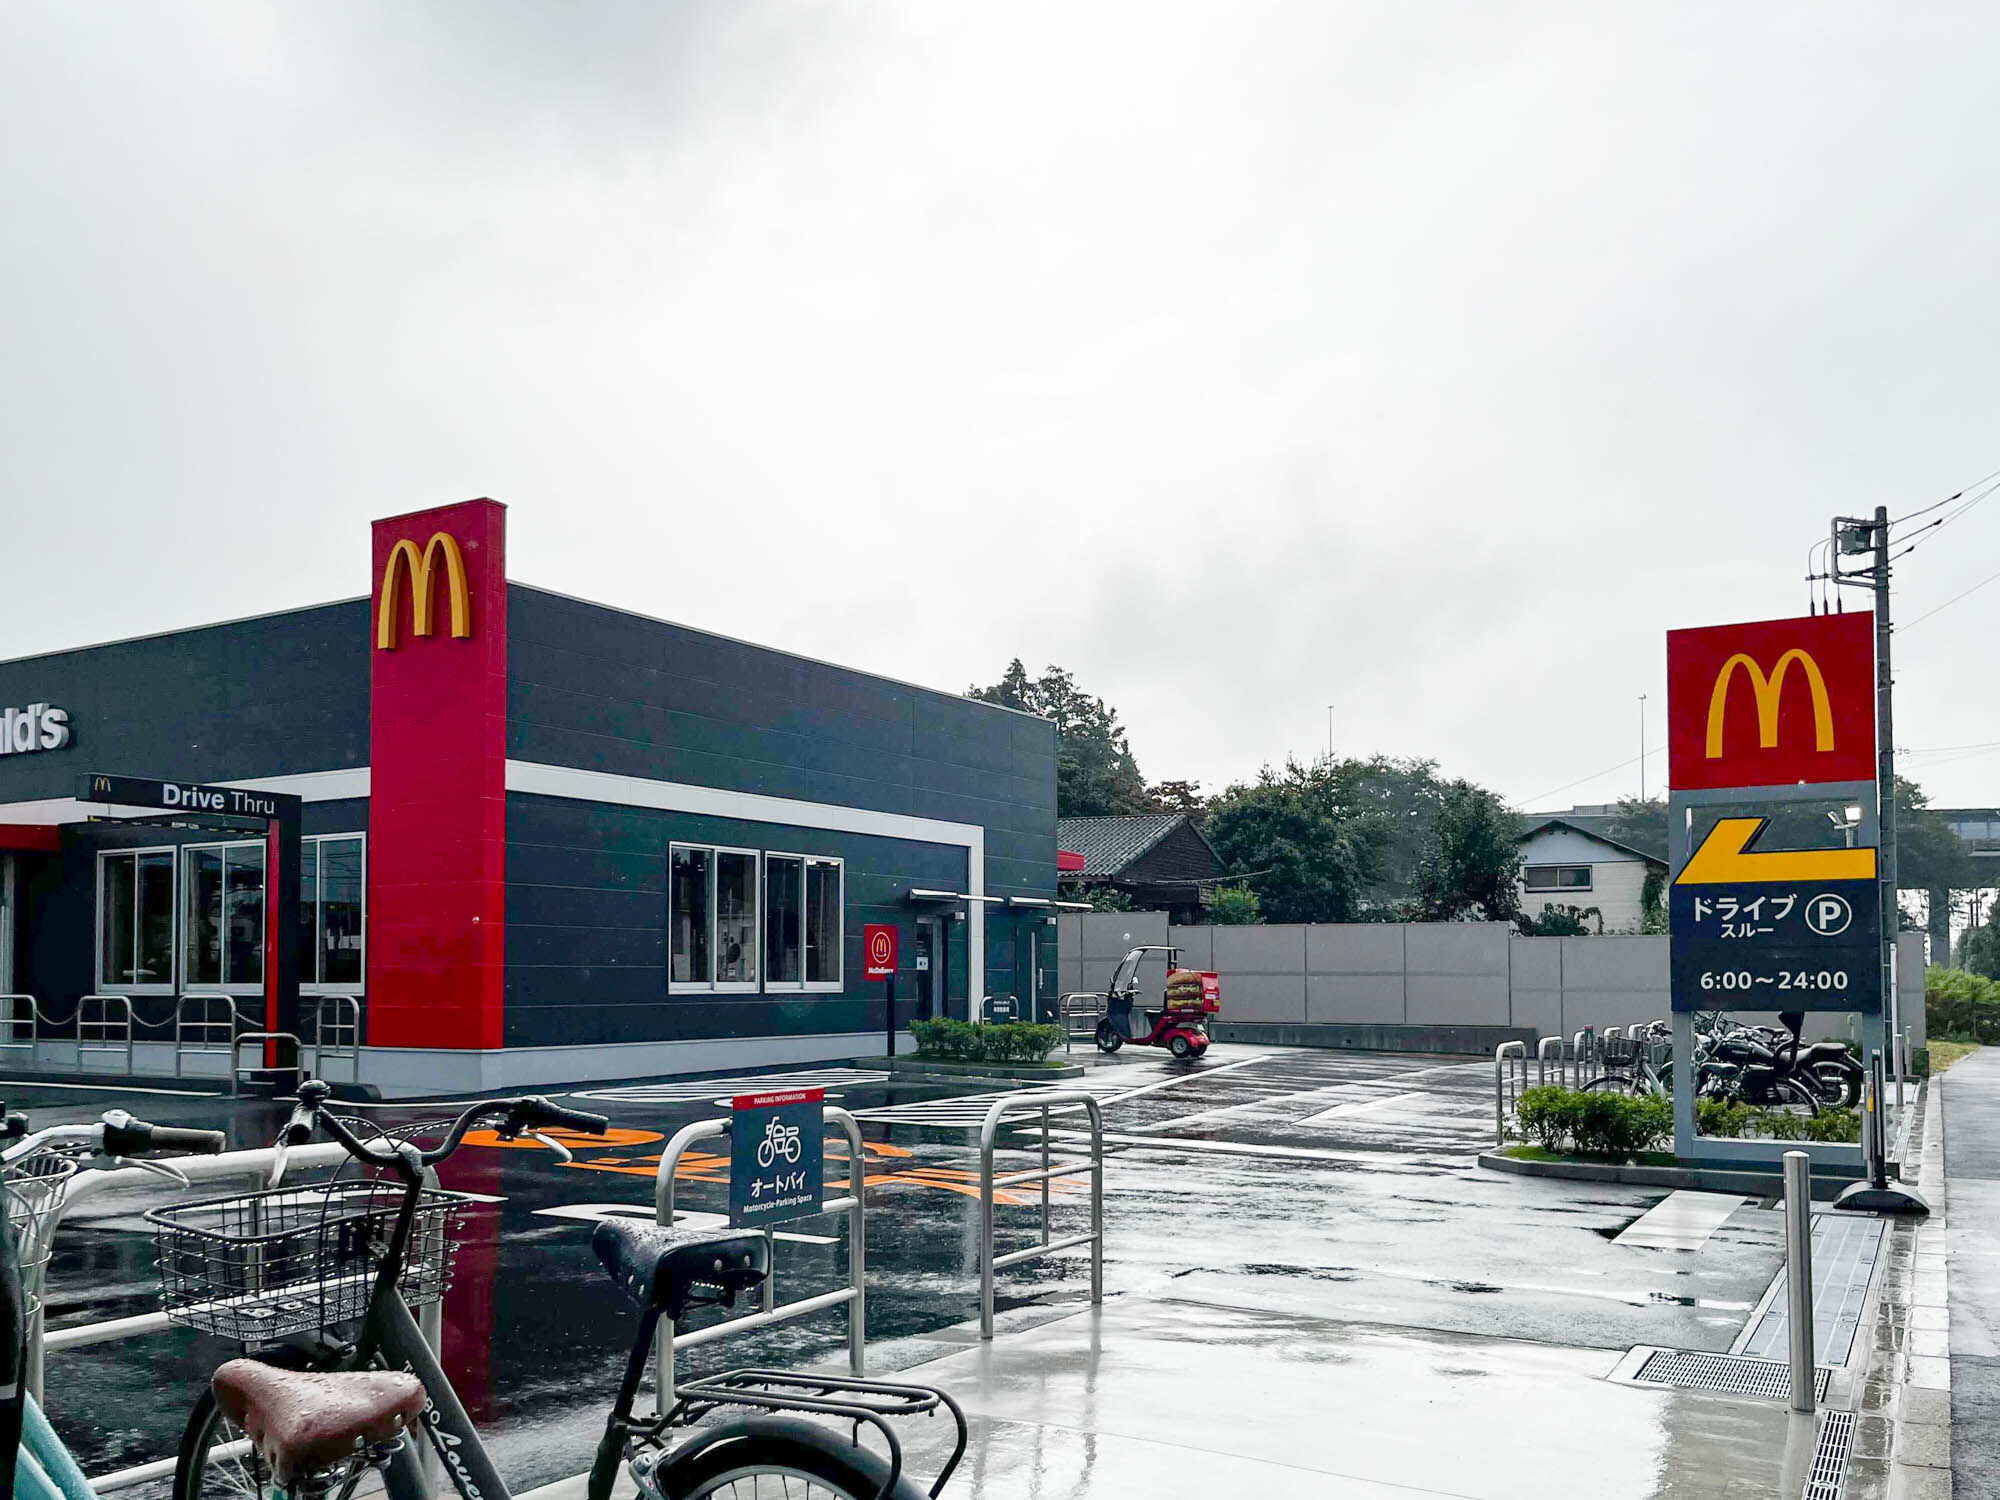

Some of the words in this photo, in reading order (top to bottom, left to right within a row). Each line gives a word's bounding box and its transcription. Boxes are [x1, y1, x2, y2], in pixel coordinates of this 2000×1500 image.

[0, 702, 69, 754] ld's
[163, 784, 225, 810] Drive
[231, 791, 275, 814] Thru
[1694, 893, 1797, 922] ドライブ
[1720, 923, 1774, 939] スルー
[754, 1095, 774, 1104] PARKING
[775, 1093, 806, 1102] INFORMATION
[751, 1170, 806, 1198] オートバイ
[797, 1194, 813, 1204] Space
